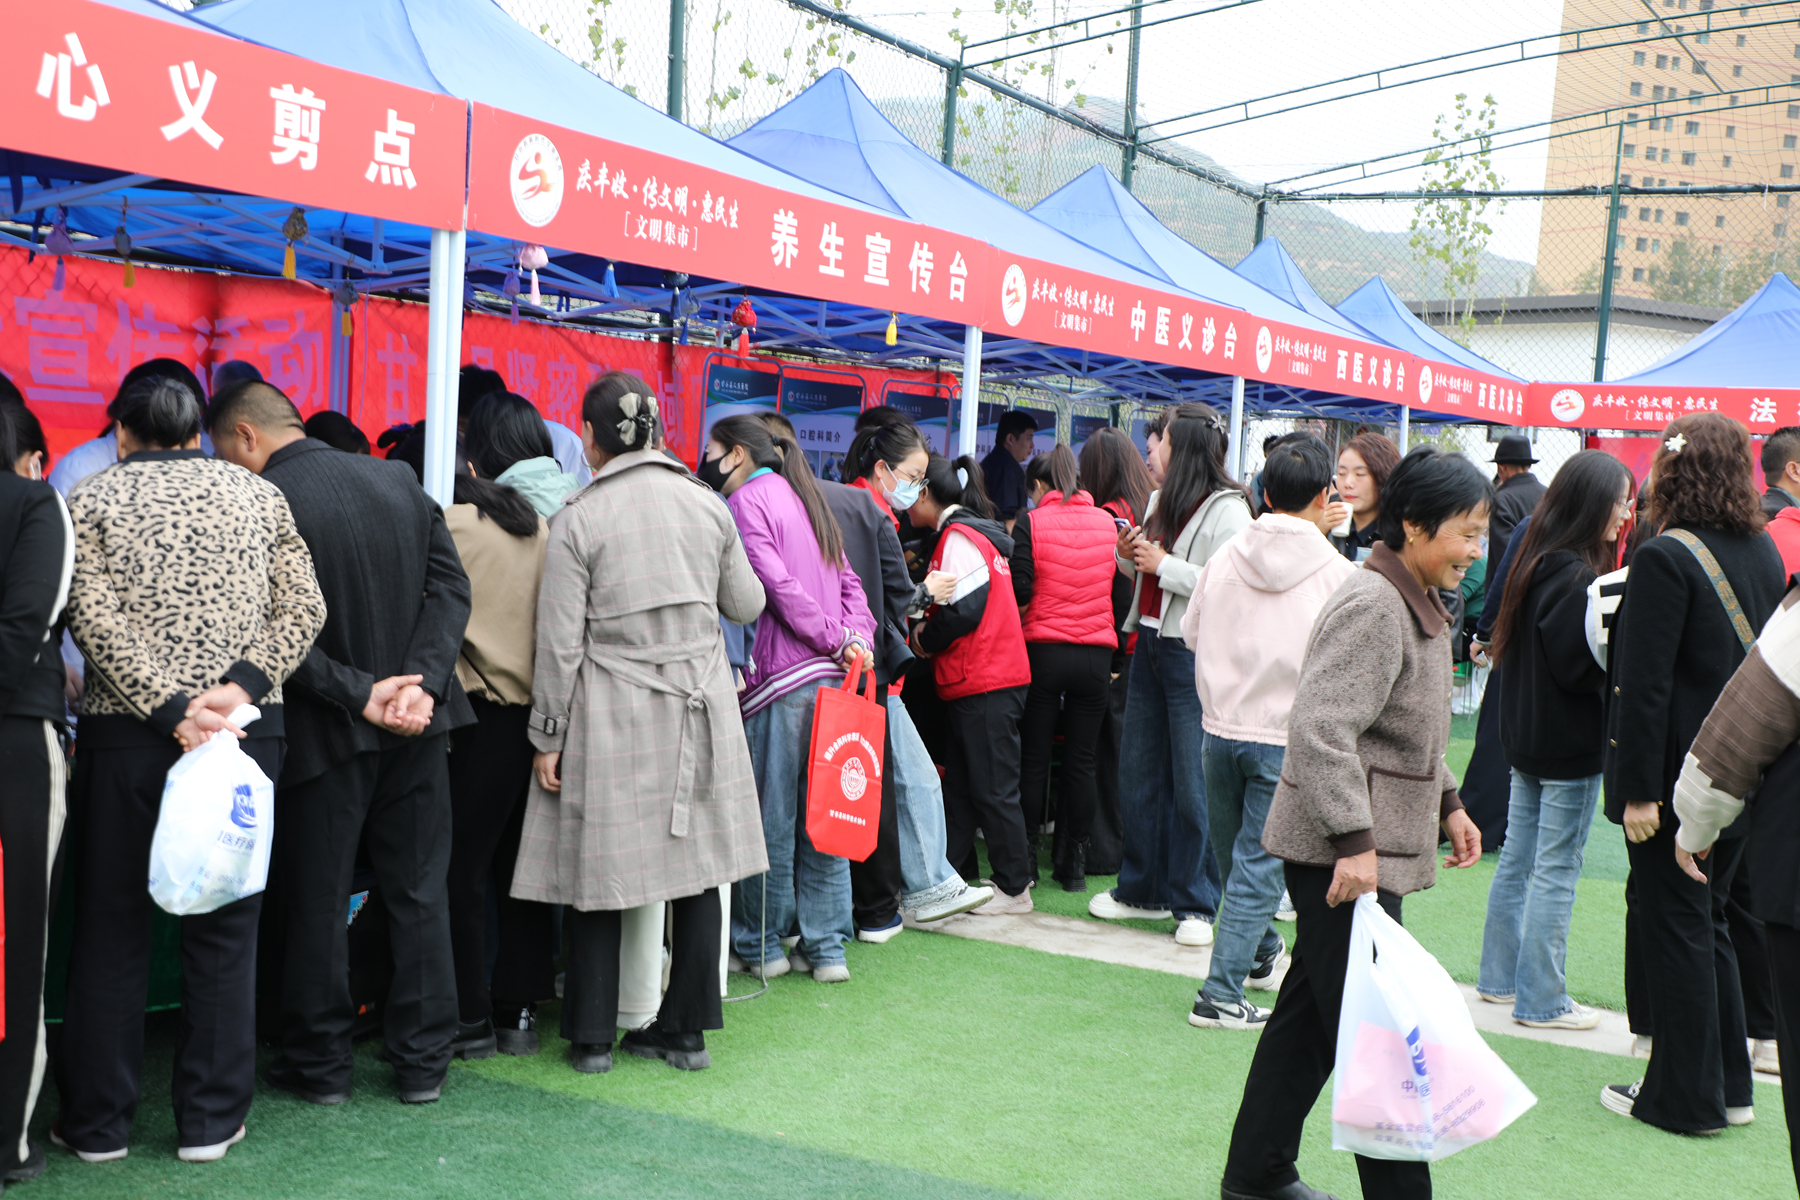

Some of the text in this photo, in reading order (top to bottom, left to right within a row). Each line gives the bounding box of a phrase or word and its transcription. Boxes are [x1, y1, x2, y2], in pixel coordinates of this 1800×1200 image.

[36, 32, 417, 190] 心义剪点
[576, 158, 739, 229] 庆丰收·传文明·惠民生
[770, 208, 968, 302] 养生宣传台
[0, 288, 324, 407] 宣传活动
[1130, 300, 1238, 360] 中医义诊台
[1336, 349, 1405, 392] 西医义诊台
[800, 429, 841, 443] 口腔科简介
